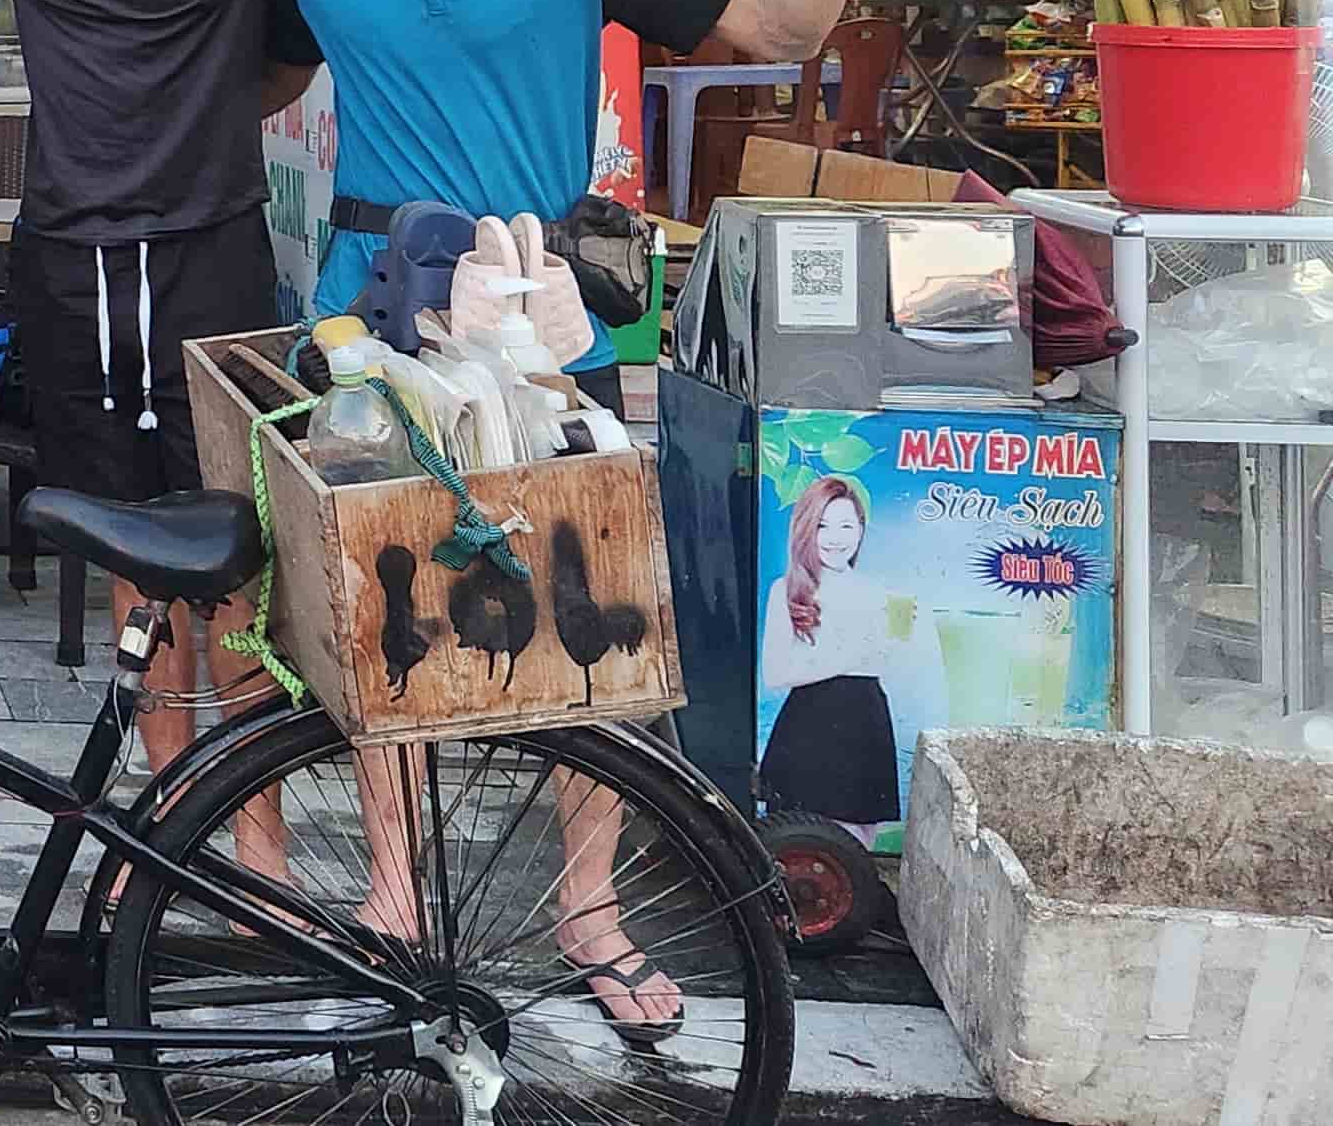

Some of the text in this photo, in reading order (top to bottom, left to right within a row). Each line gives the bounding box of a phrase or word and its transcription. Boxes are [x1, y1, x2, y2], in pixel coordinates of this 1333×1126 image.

[897, 426, 1105, 480] MÁY ÉP MÍA
[917, 481, 1105, 532] Siêu Sạch
[1001, 553, 1040, 582] Siêu
